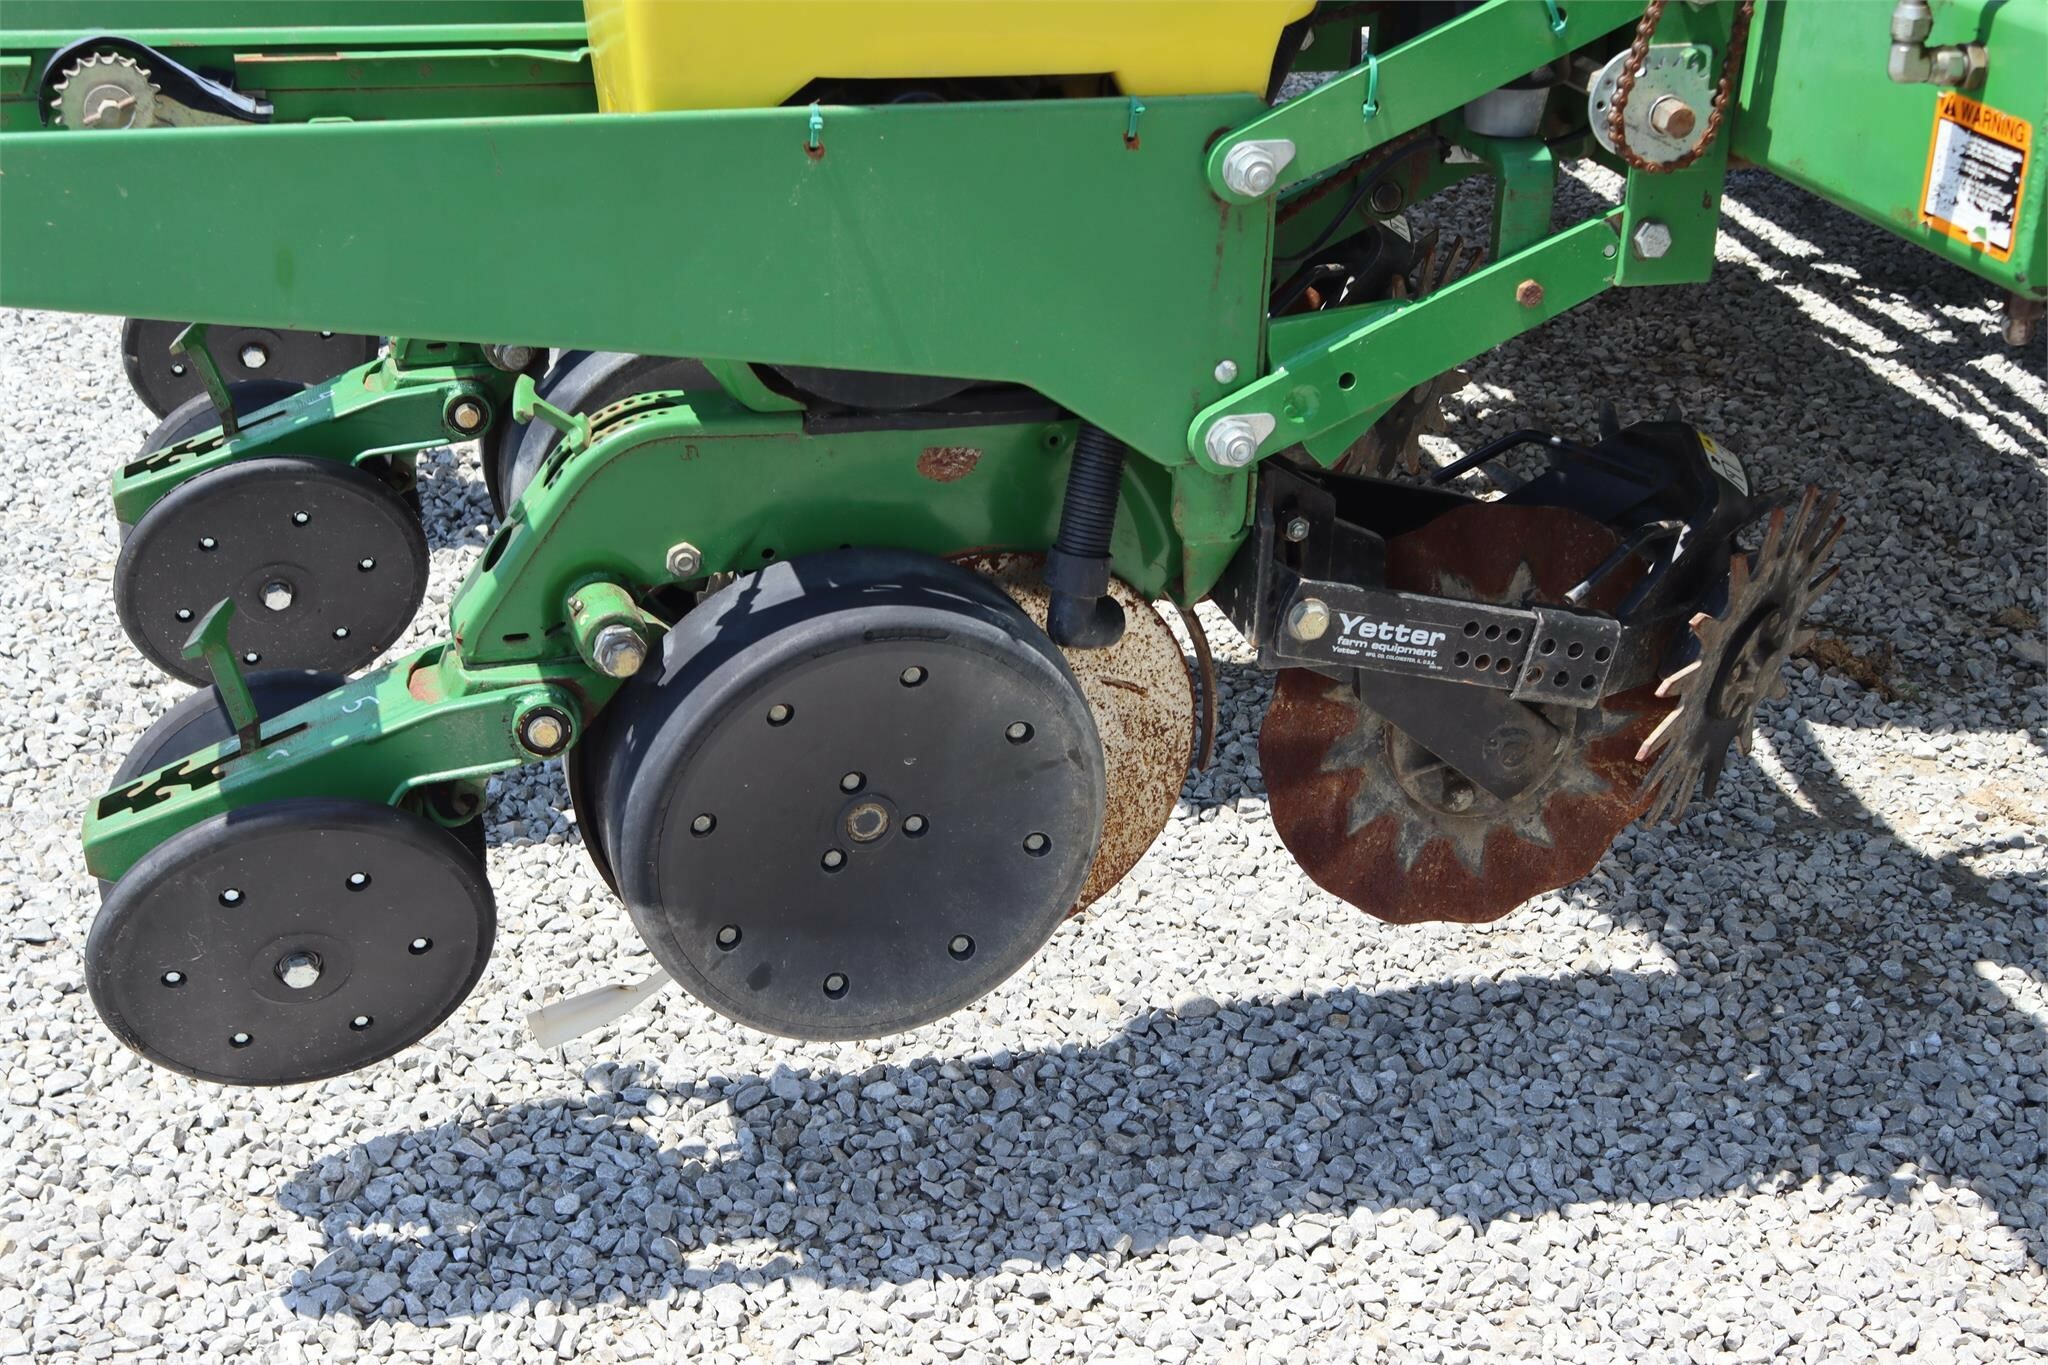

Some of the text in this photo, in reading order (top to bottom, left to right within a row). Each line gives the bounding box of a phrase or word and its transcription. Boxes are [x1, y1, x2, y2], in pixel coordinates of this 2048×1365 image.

[1961, 102, 2026, 142] WARNING
[1339, 612, 1446, 646] Yetter
[1331, 645, 1360, 655] Yetter
[1337, 635, 1438, 657] farm equipment
